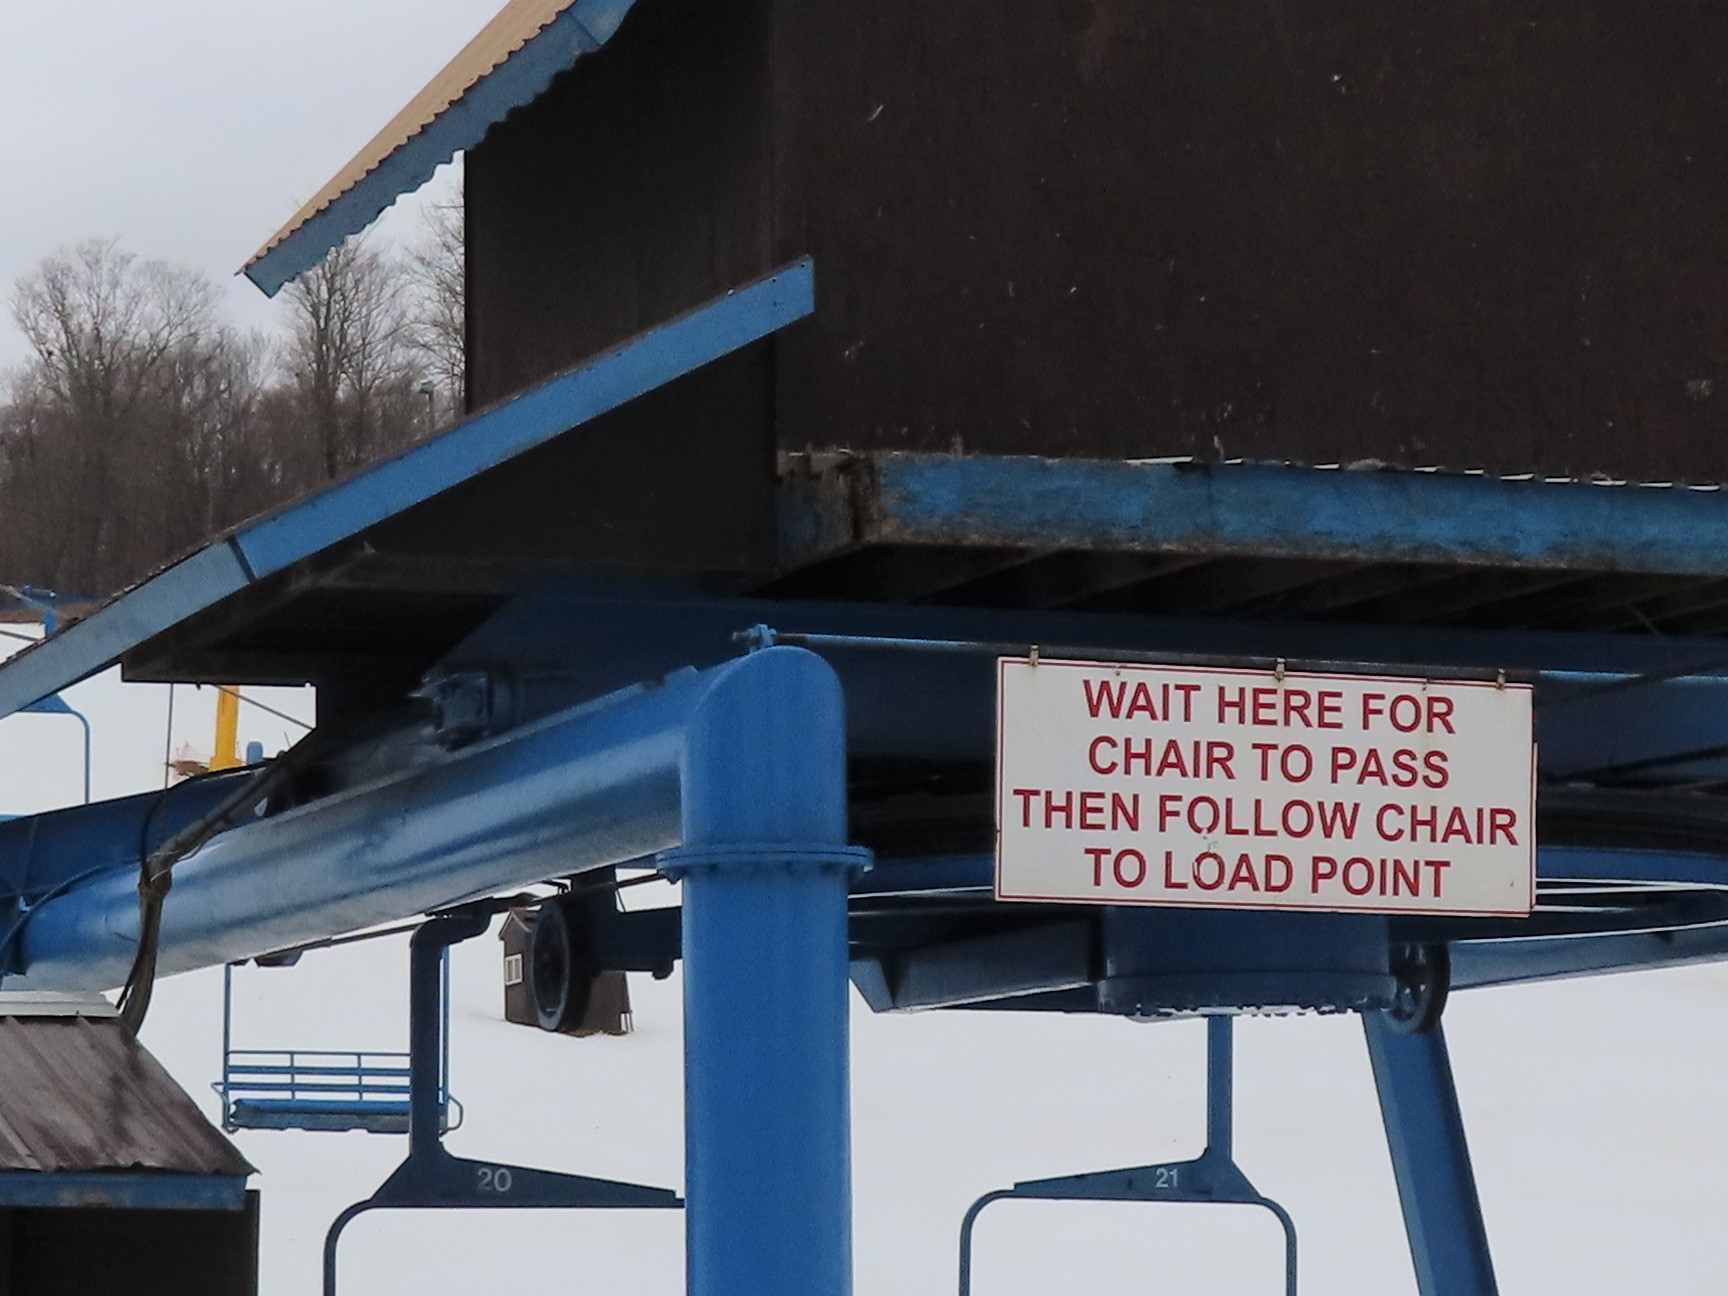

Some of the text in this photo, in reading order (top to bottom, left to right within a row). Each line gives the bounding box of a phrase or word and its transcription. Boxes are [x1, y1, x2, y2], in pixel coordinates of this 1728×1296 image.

[1082, 679, 1456, 735] WAIT HERE FOR
[1087, 735, 1450, 789] CHAIR TO PASS
[1013, 788, 1520, 846] THEN FOLLOW CHAIR
[1084, 848, 1451, 898] TO LOAD POINT
[477, 1168, 512, 1192] 20
[1155, 1168, 1179, 1188] 21
